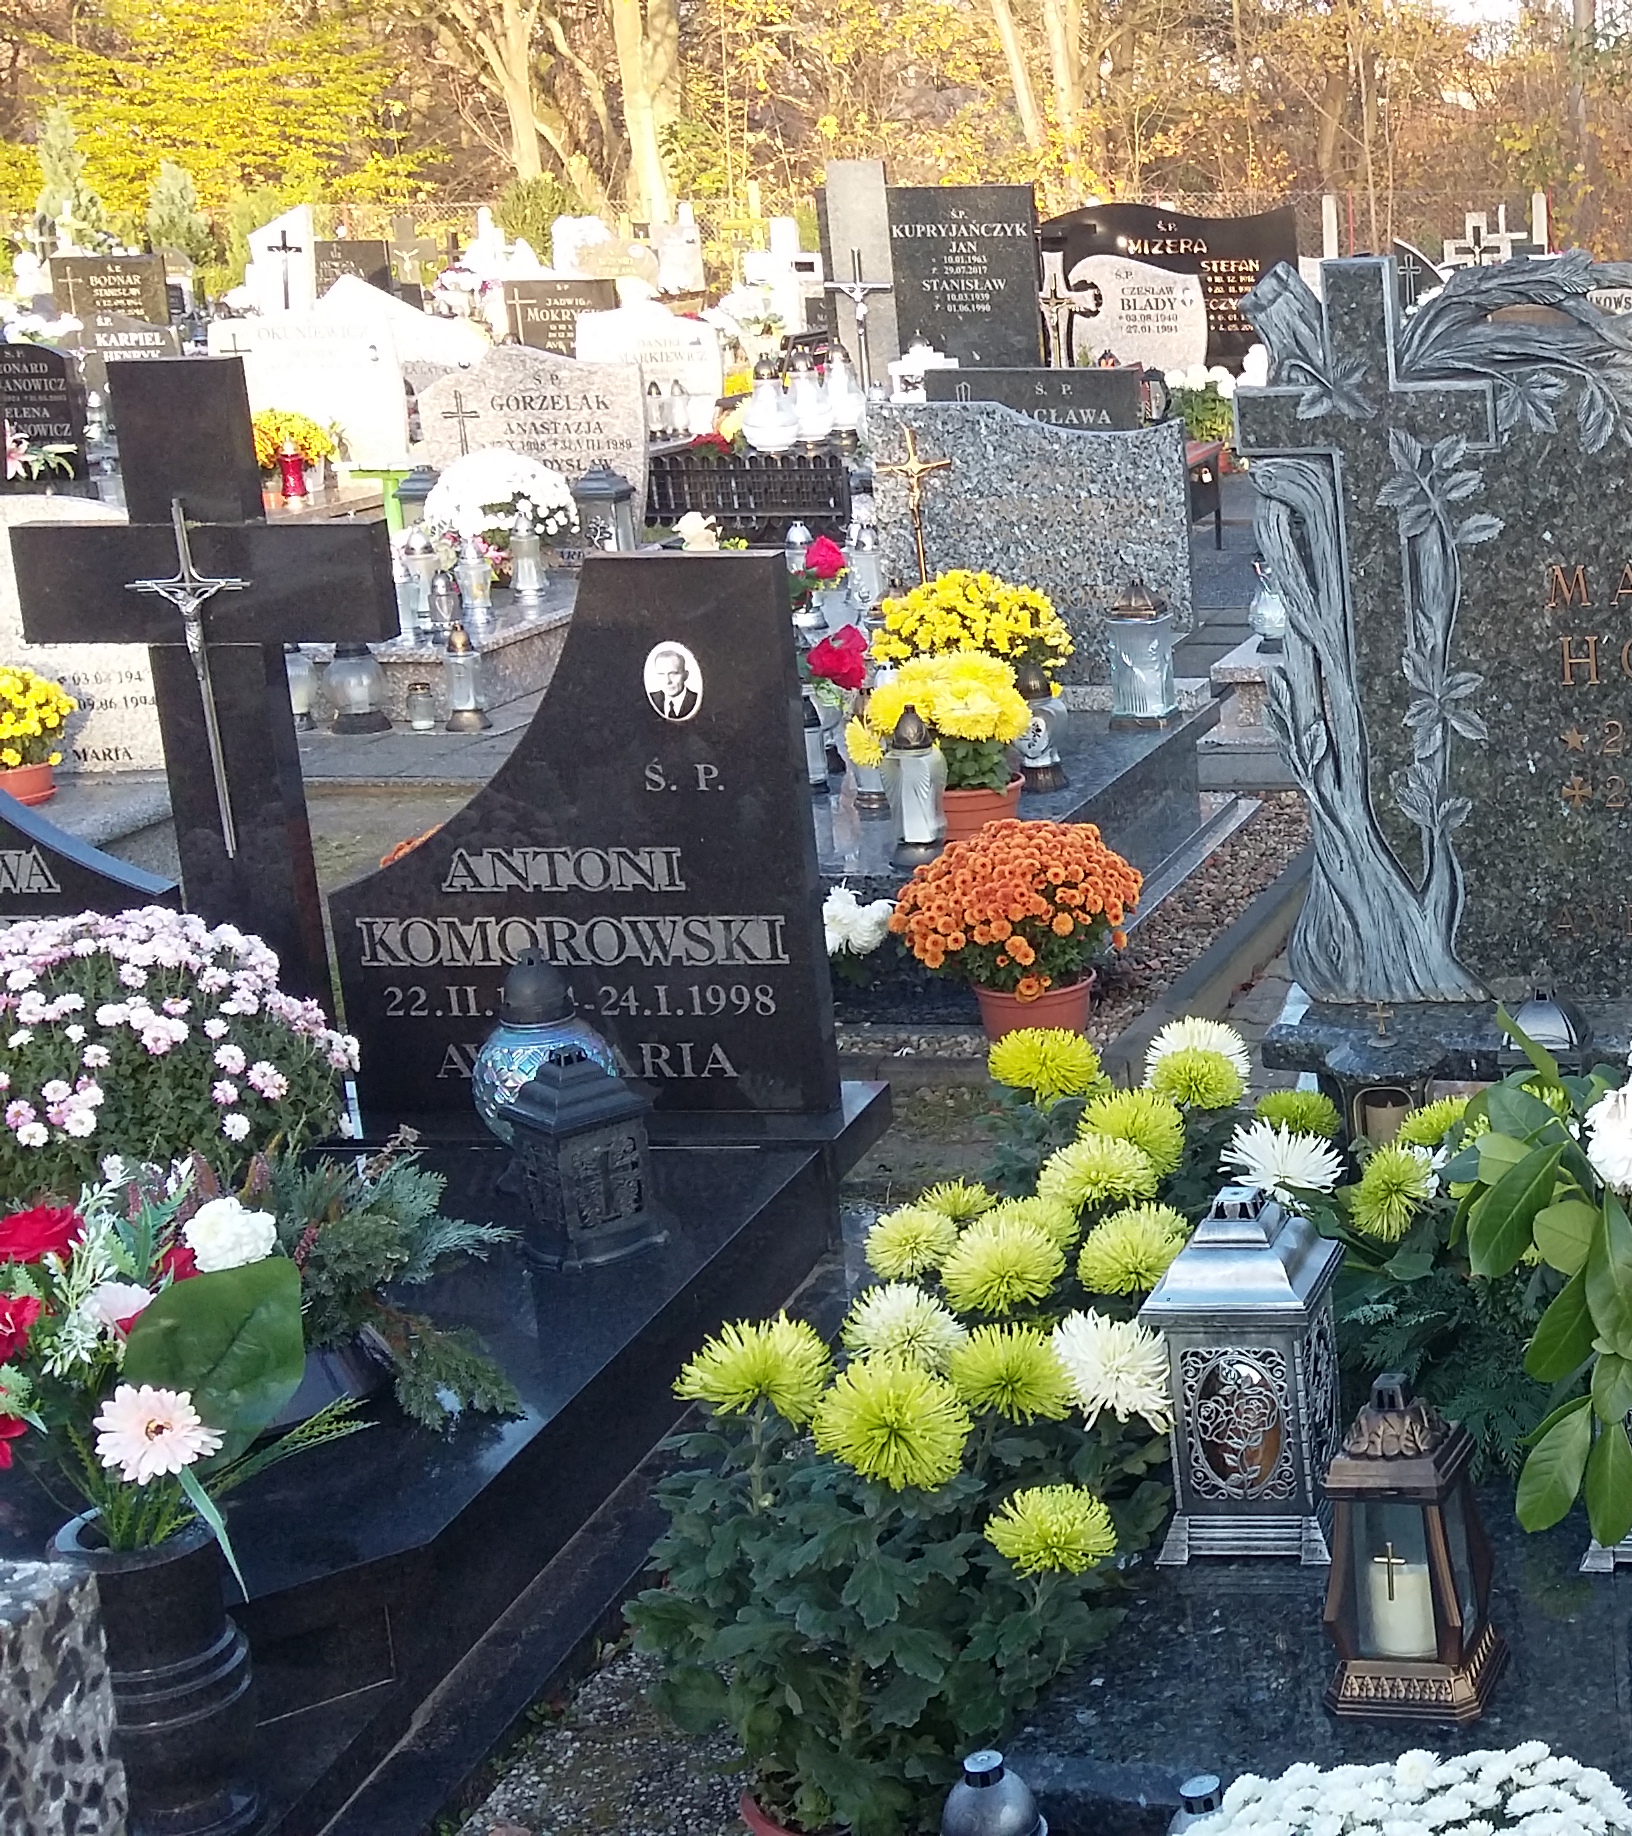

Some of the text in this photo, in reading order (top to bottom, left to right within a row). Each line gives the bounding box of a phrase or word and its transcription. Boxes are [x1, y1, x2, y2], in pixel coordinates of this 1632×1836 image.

[892, 219, 1028, 238] KUPRYJAŃCZYK
[948, 240, 977, 253] JAN
[1127, 238, 1208, 255] MIZERA
[1200, 259, 1260, 273] STEFAN
[89, 275, 142, 287] BODNAR
[922, 278, 1007, 292] STANISŁAW
[95, 332, 166, 347] KARPIEL
[1035, 381, 1073, 396] Ś. P.
[490, 394, 610, 412] GORZELAK
[1020, 408, 1112, 424] ACŁAWA
[503, 421, 604, 435] ANASTAZJA
[645, 757, 725, 792] Ś. P.
[441, 846, 687, 893] ANTONI
[359, 914, 790, 967] KOMOROWSKI
[614, 1042, 741, 1079] ARIA
